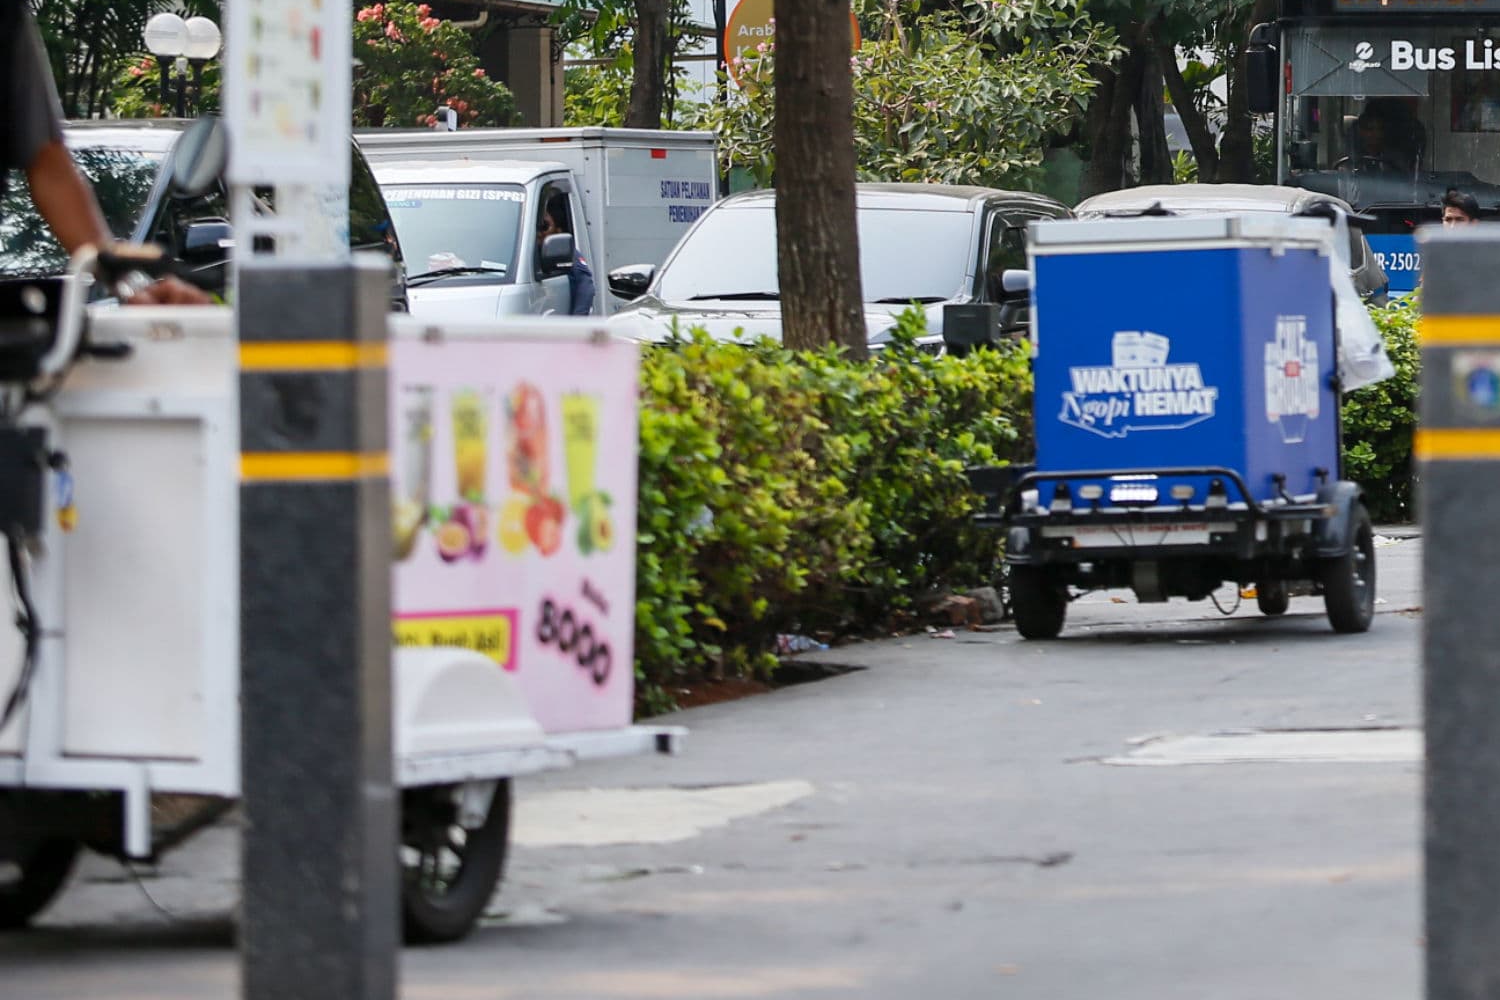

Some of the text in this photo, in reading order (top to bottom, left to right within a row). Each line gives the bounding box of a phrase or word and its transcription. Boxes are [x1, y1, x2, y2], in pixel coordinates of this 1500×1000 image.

[1390, 40, 1456, 70] Bus
[1072, 367, 1201, 393] WAKTUNYA
[1062, 388, 1215, 425] Ngopi HEMAT
